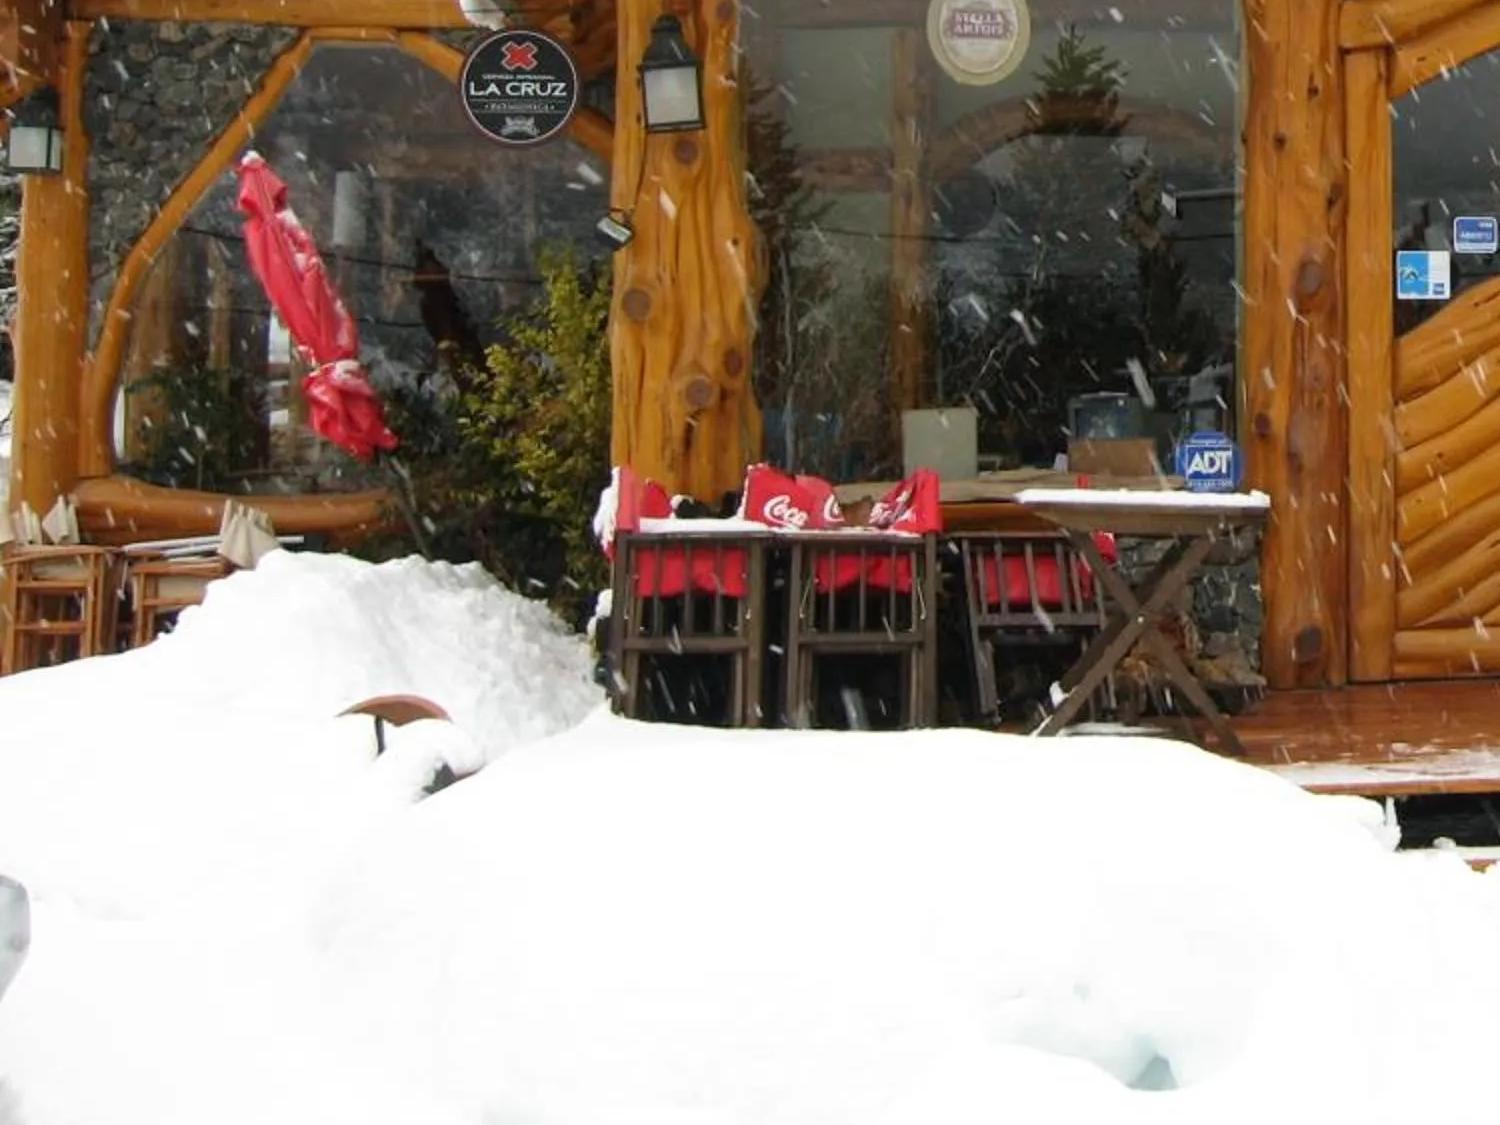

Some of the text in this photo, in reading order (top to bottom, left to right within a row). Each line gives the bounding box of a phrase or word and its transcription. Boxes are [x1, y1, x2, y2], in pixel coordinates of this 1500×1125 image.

[469, 81, 568, 96] LA CRUZ
[1187, 449, 1233, 475] ADT
